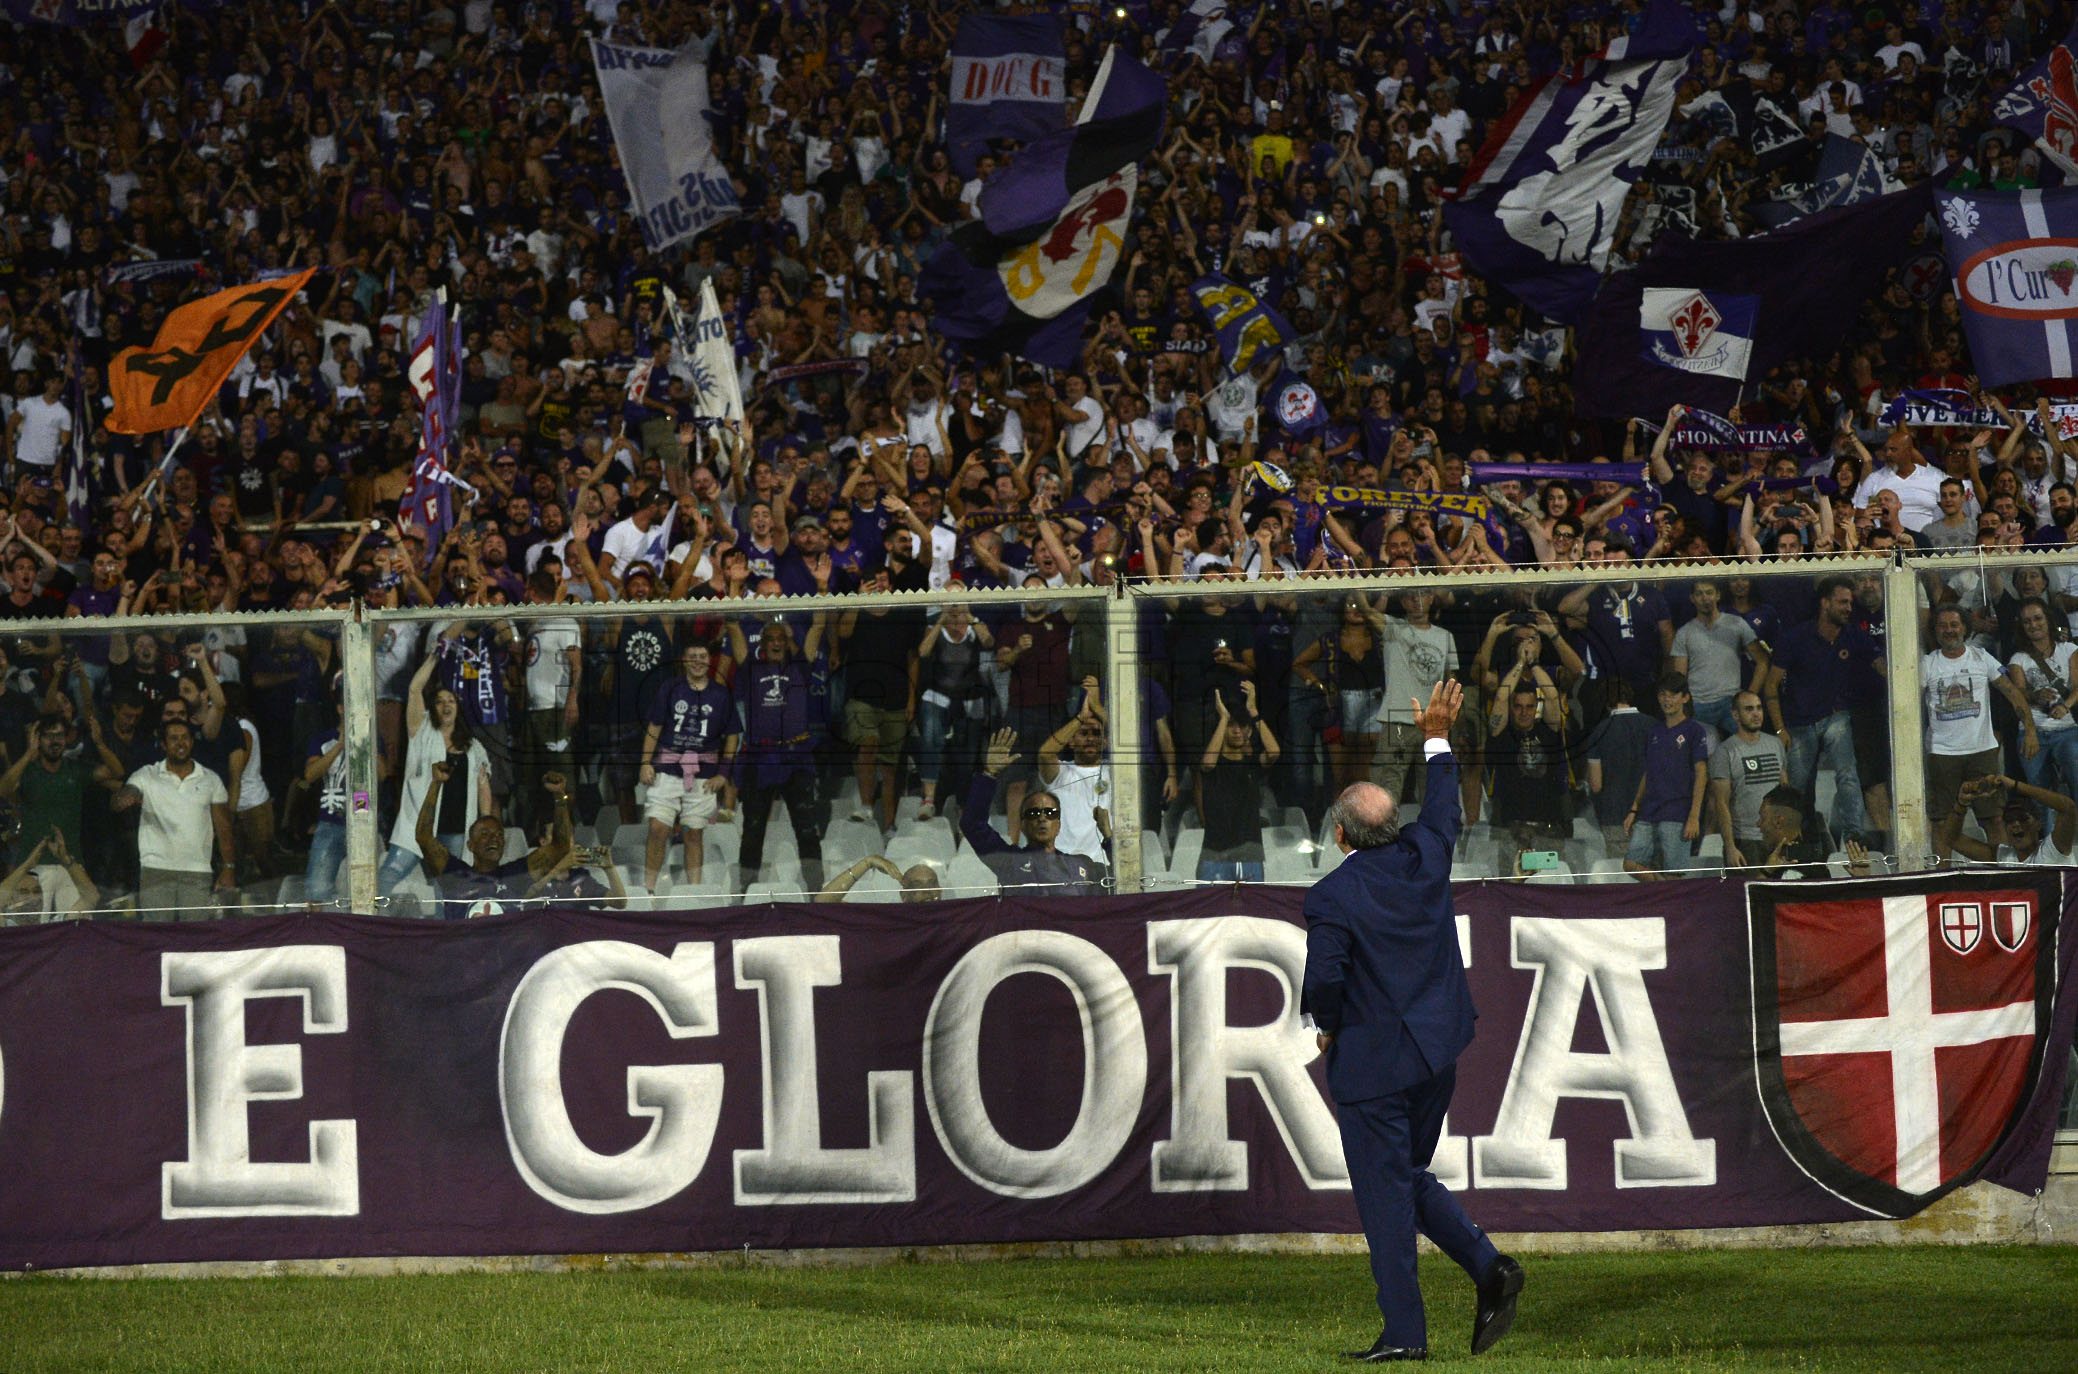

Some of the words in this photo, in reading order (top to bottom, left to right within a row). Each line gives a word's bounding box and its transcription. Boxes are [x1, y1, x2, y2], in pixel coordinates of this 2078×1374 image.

[1677, 429, 1790, 445] FIORNTINA
[1315, 485, 1488, 521] FOREVER
[1363, 499, 1438, 511] FIORENTINA
[161, 945, 359, 1220] E
